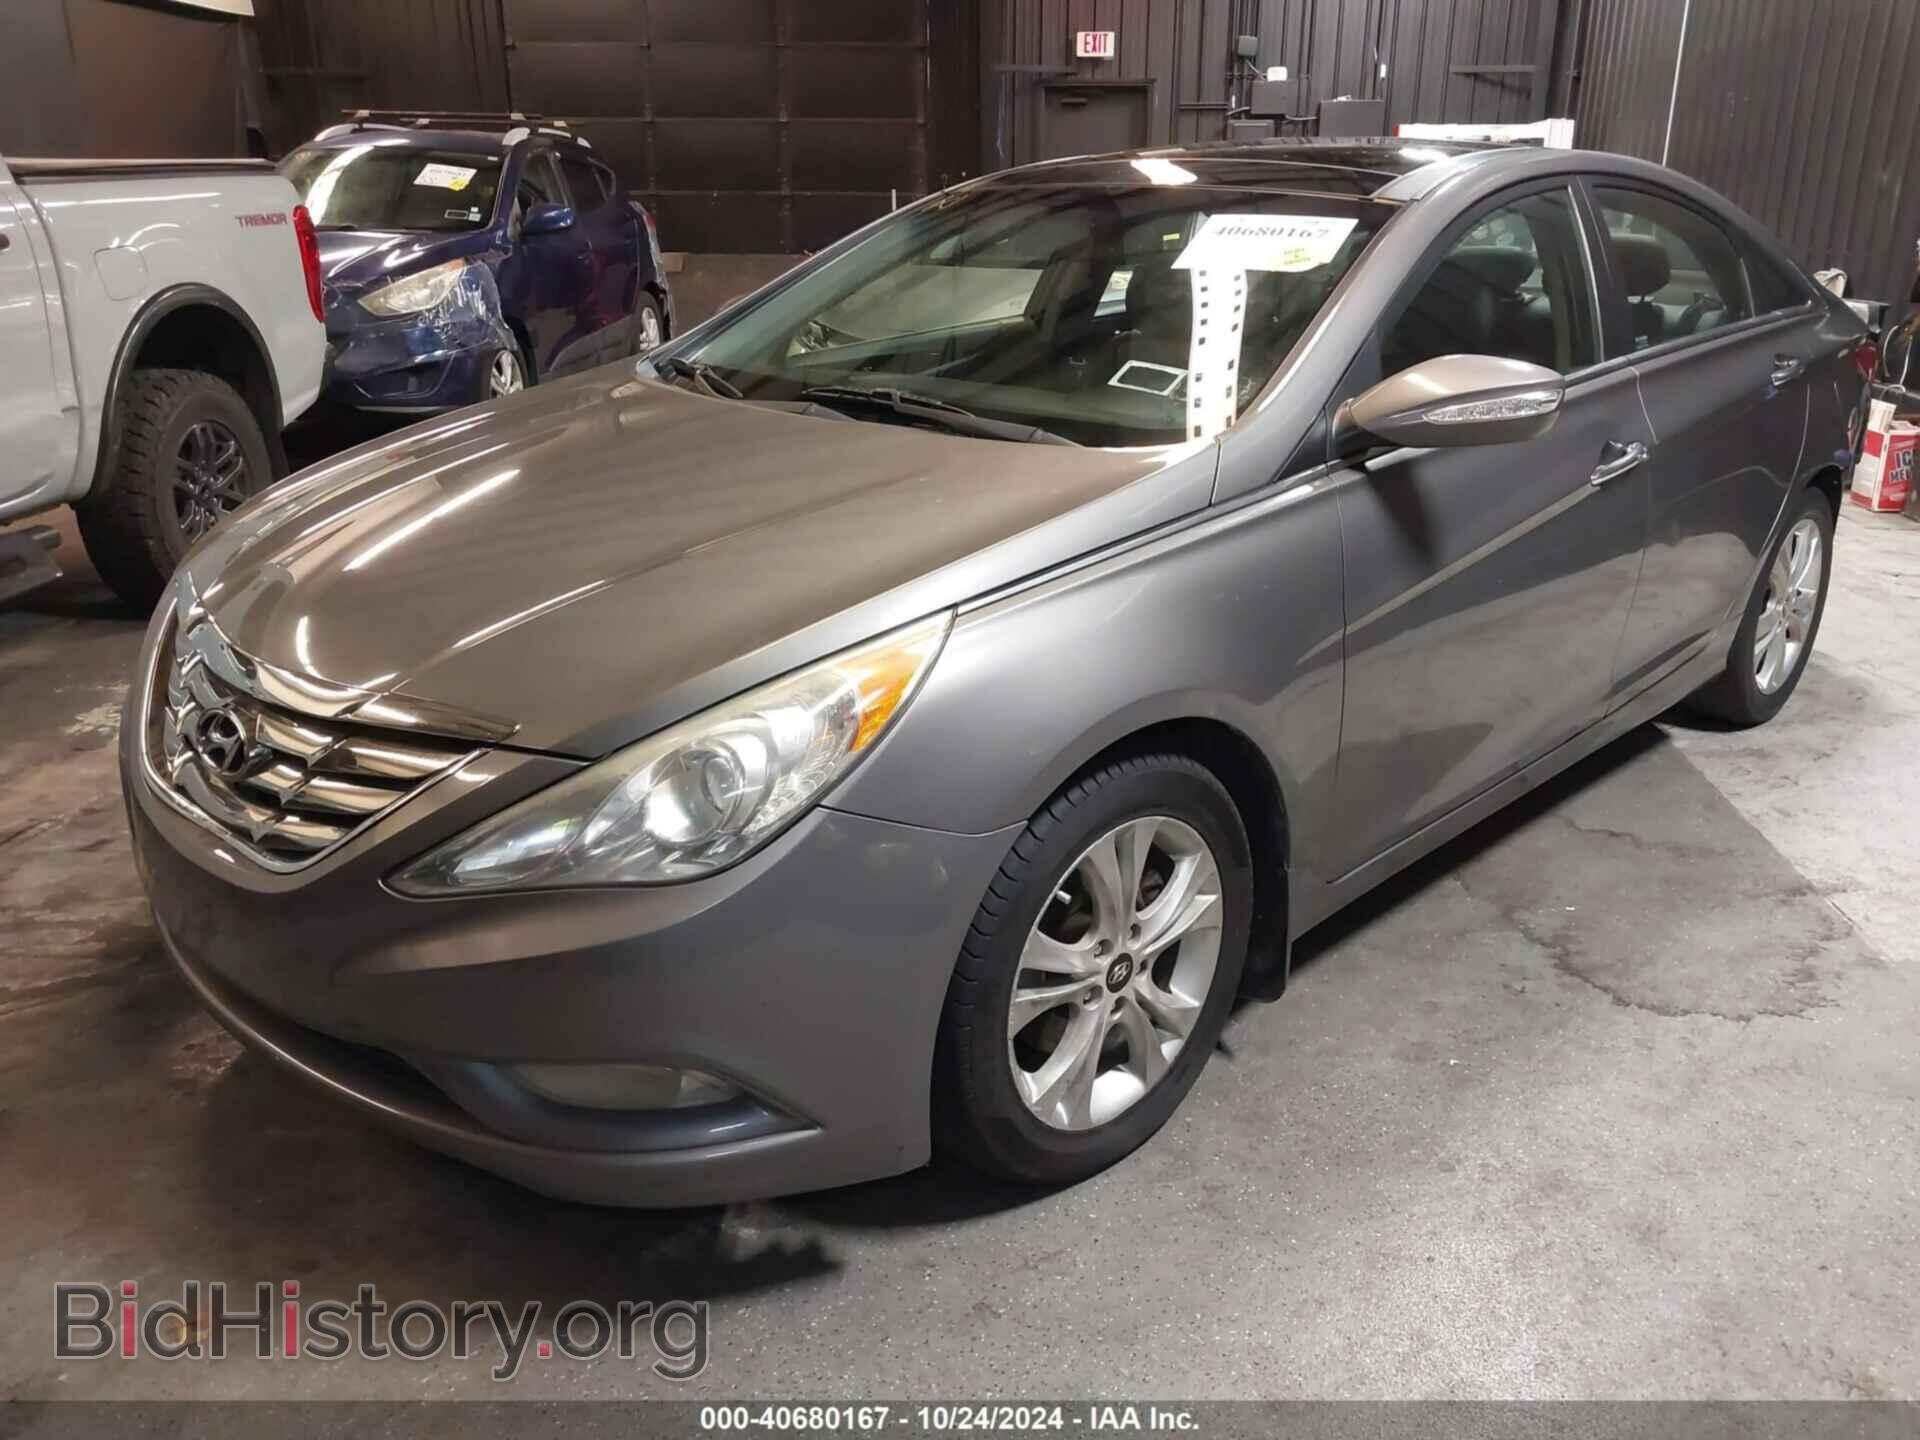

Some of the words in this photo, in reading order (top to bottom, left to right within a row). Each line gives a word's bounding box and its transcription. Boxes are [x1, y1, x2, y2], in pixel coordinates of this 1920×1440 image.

[1084, 33, 1109, 53] EXIT
[235, 213, 288, 227] TREMOR
[1214, 225, 1330, 239] 40680167
